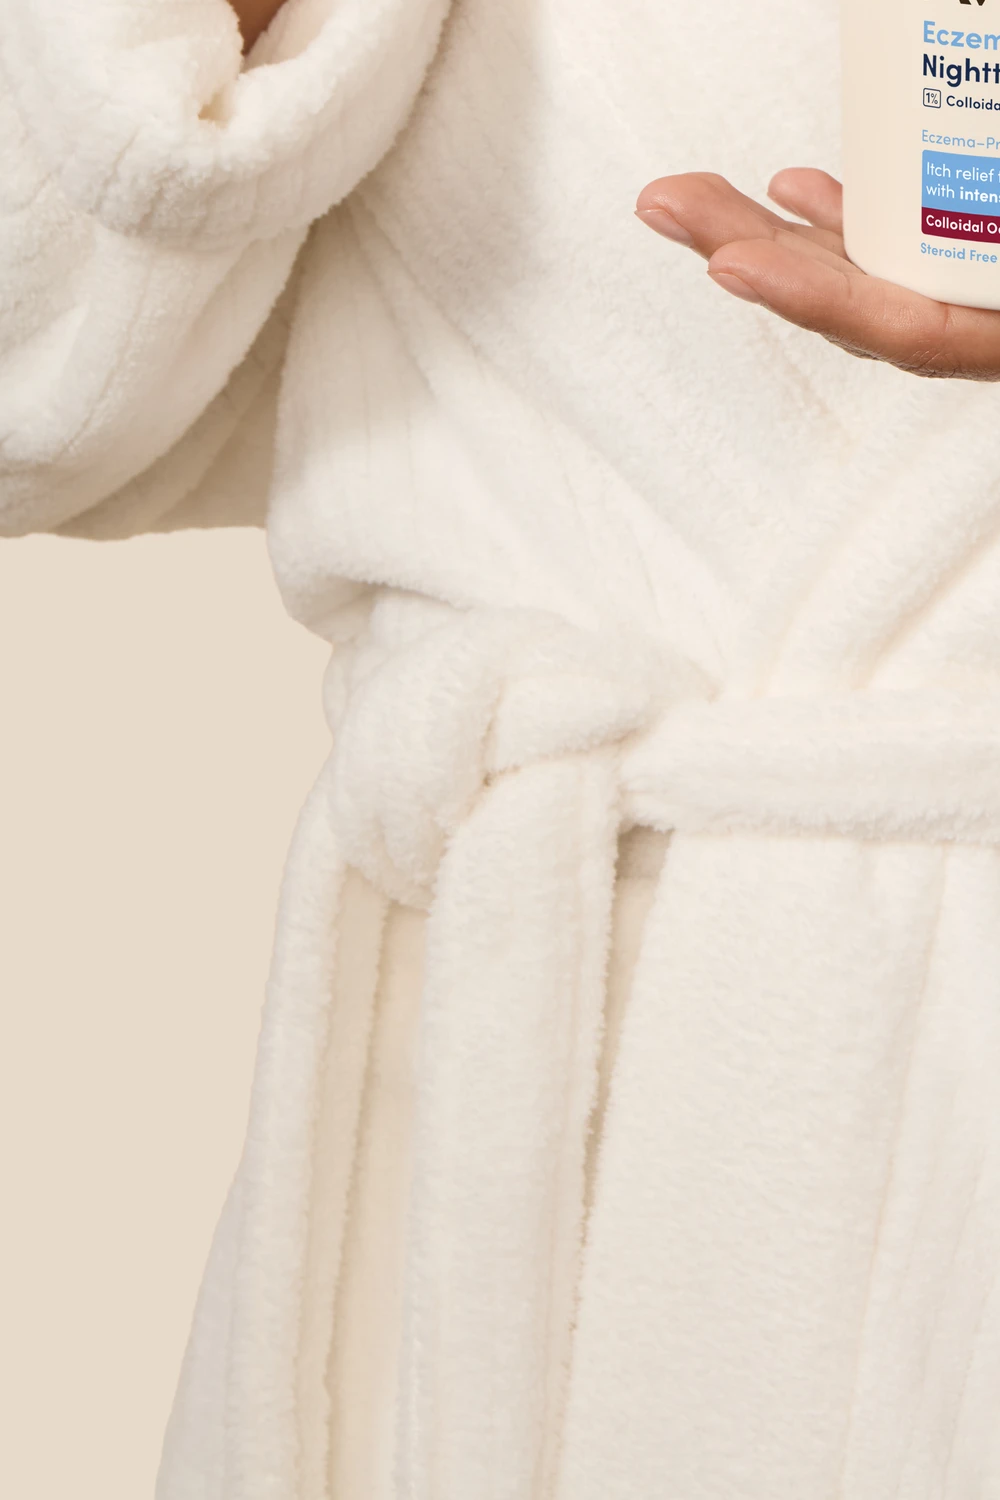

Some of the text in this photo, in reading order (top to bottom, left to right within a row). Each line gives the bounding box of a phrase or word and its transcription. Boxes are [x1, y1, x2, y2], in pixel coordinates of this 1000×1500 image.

[925, 92, 939, 105] 1%
[926, 162, 951, 178] Itch
[955, 167, 995, 183] relief
[926, 184, 955, 199] with
[925, 214, 984, 234] Colloidal
[920, 242, 966, 261] Steroid
[969, 250, 998, 264] Free
